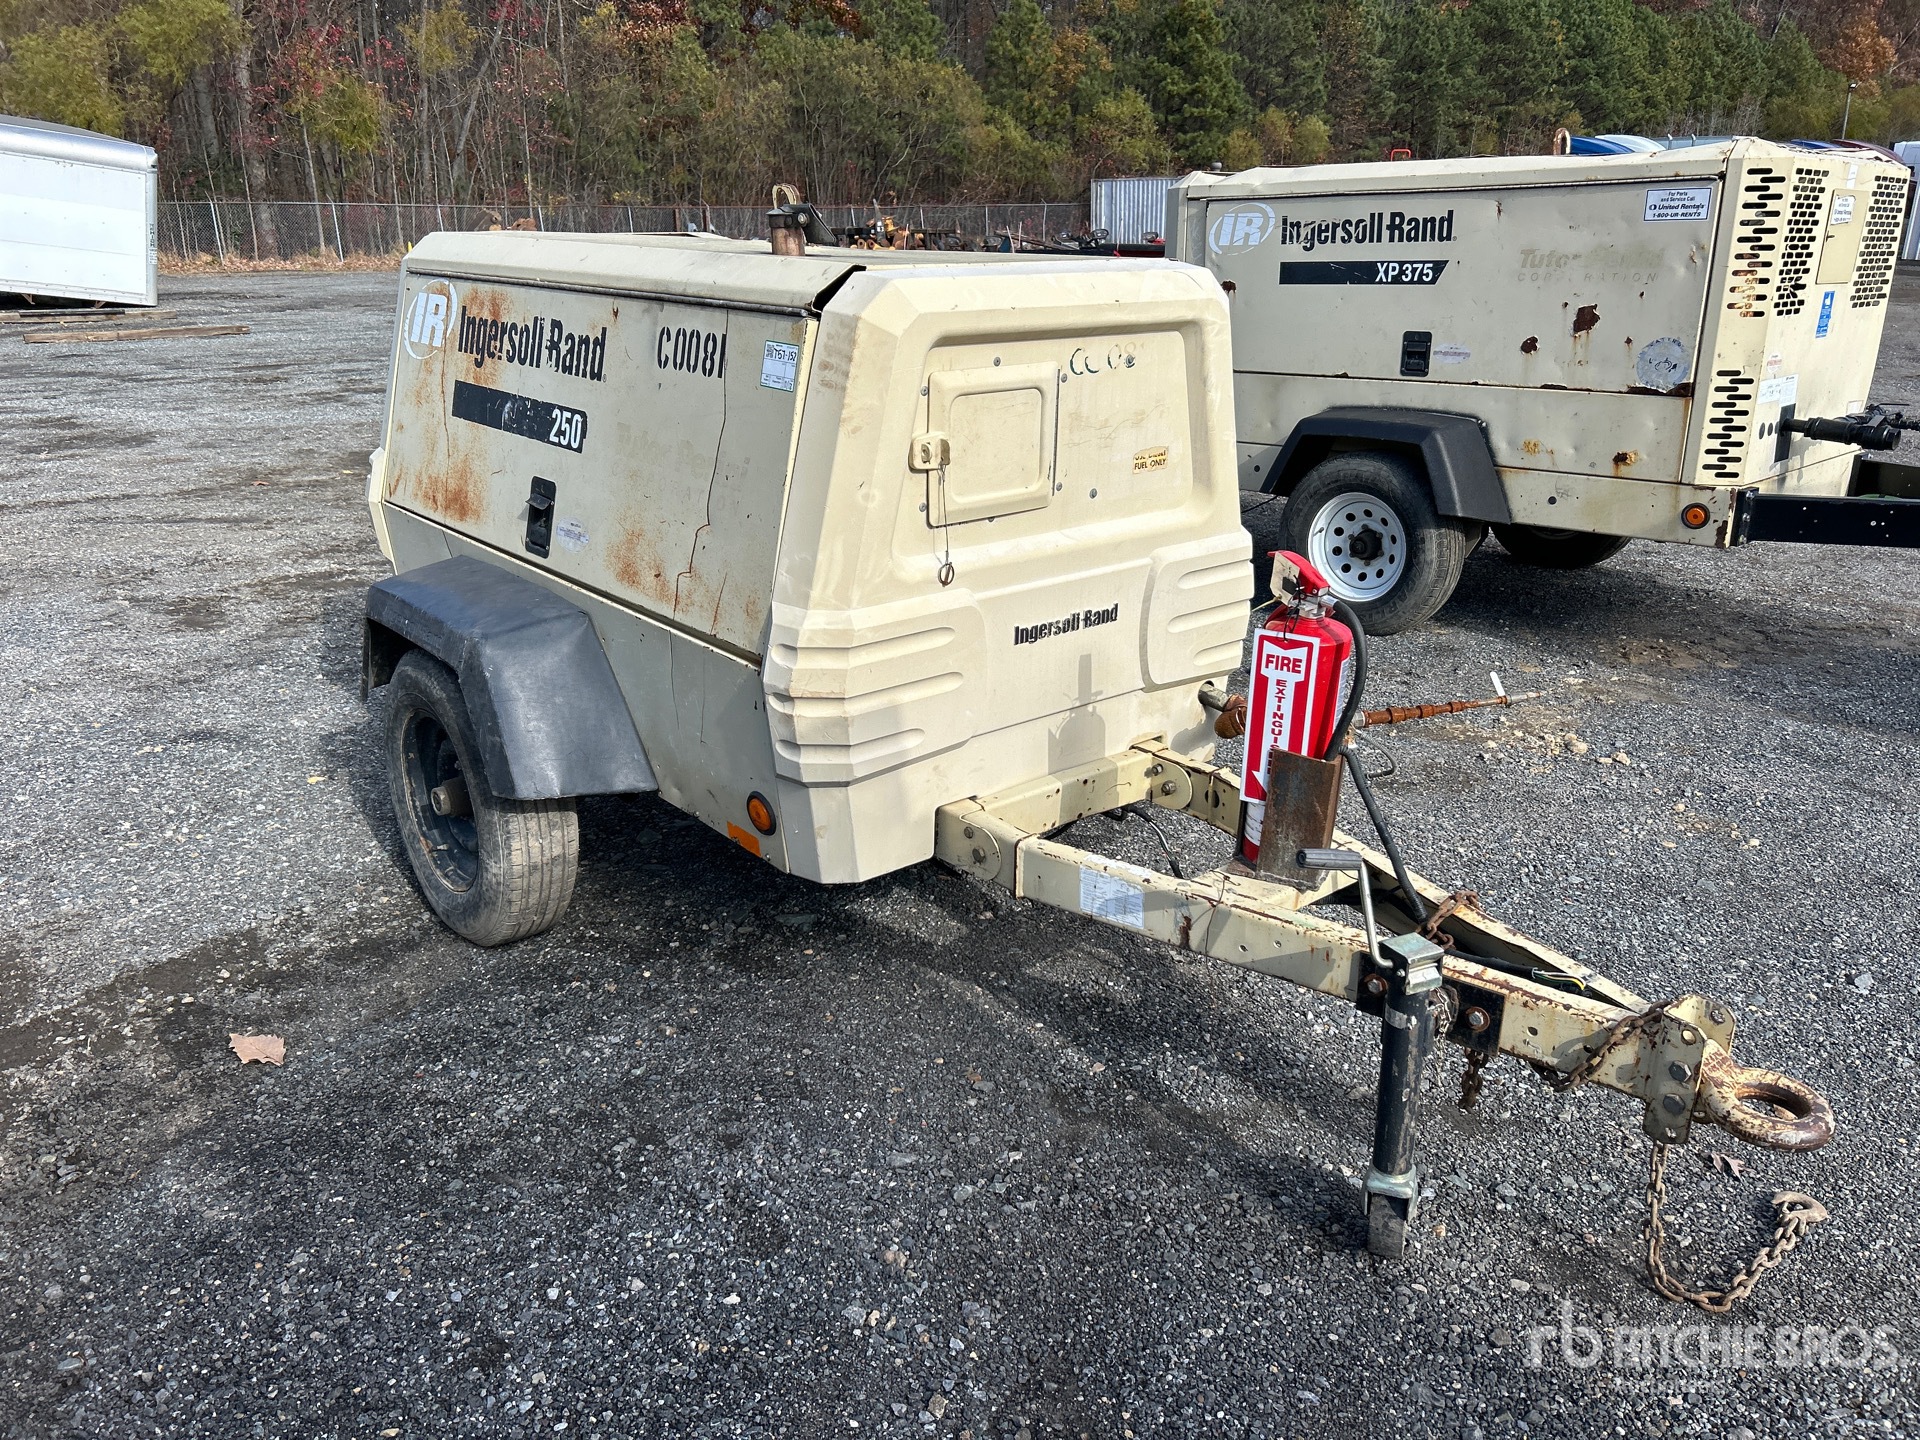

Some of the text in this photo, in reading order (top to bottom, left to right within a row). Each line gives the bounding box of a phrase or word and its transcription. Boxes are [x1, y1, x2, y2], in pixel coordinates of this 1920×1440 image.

[1658, 203, 1680, 211] United
[1218, 212, 1265, 246] IR
[410, 291, 448, 348] IR
[549, 408, 582, 449] 250
[1134, 461, 1148, 470] FUEL
[1150, 458, 1167, 468] ONLY
[1264, 653, 1302, 674] FIRE
[1266, 678, 1288, 775] EXTINGUI
